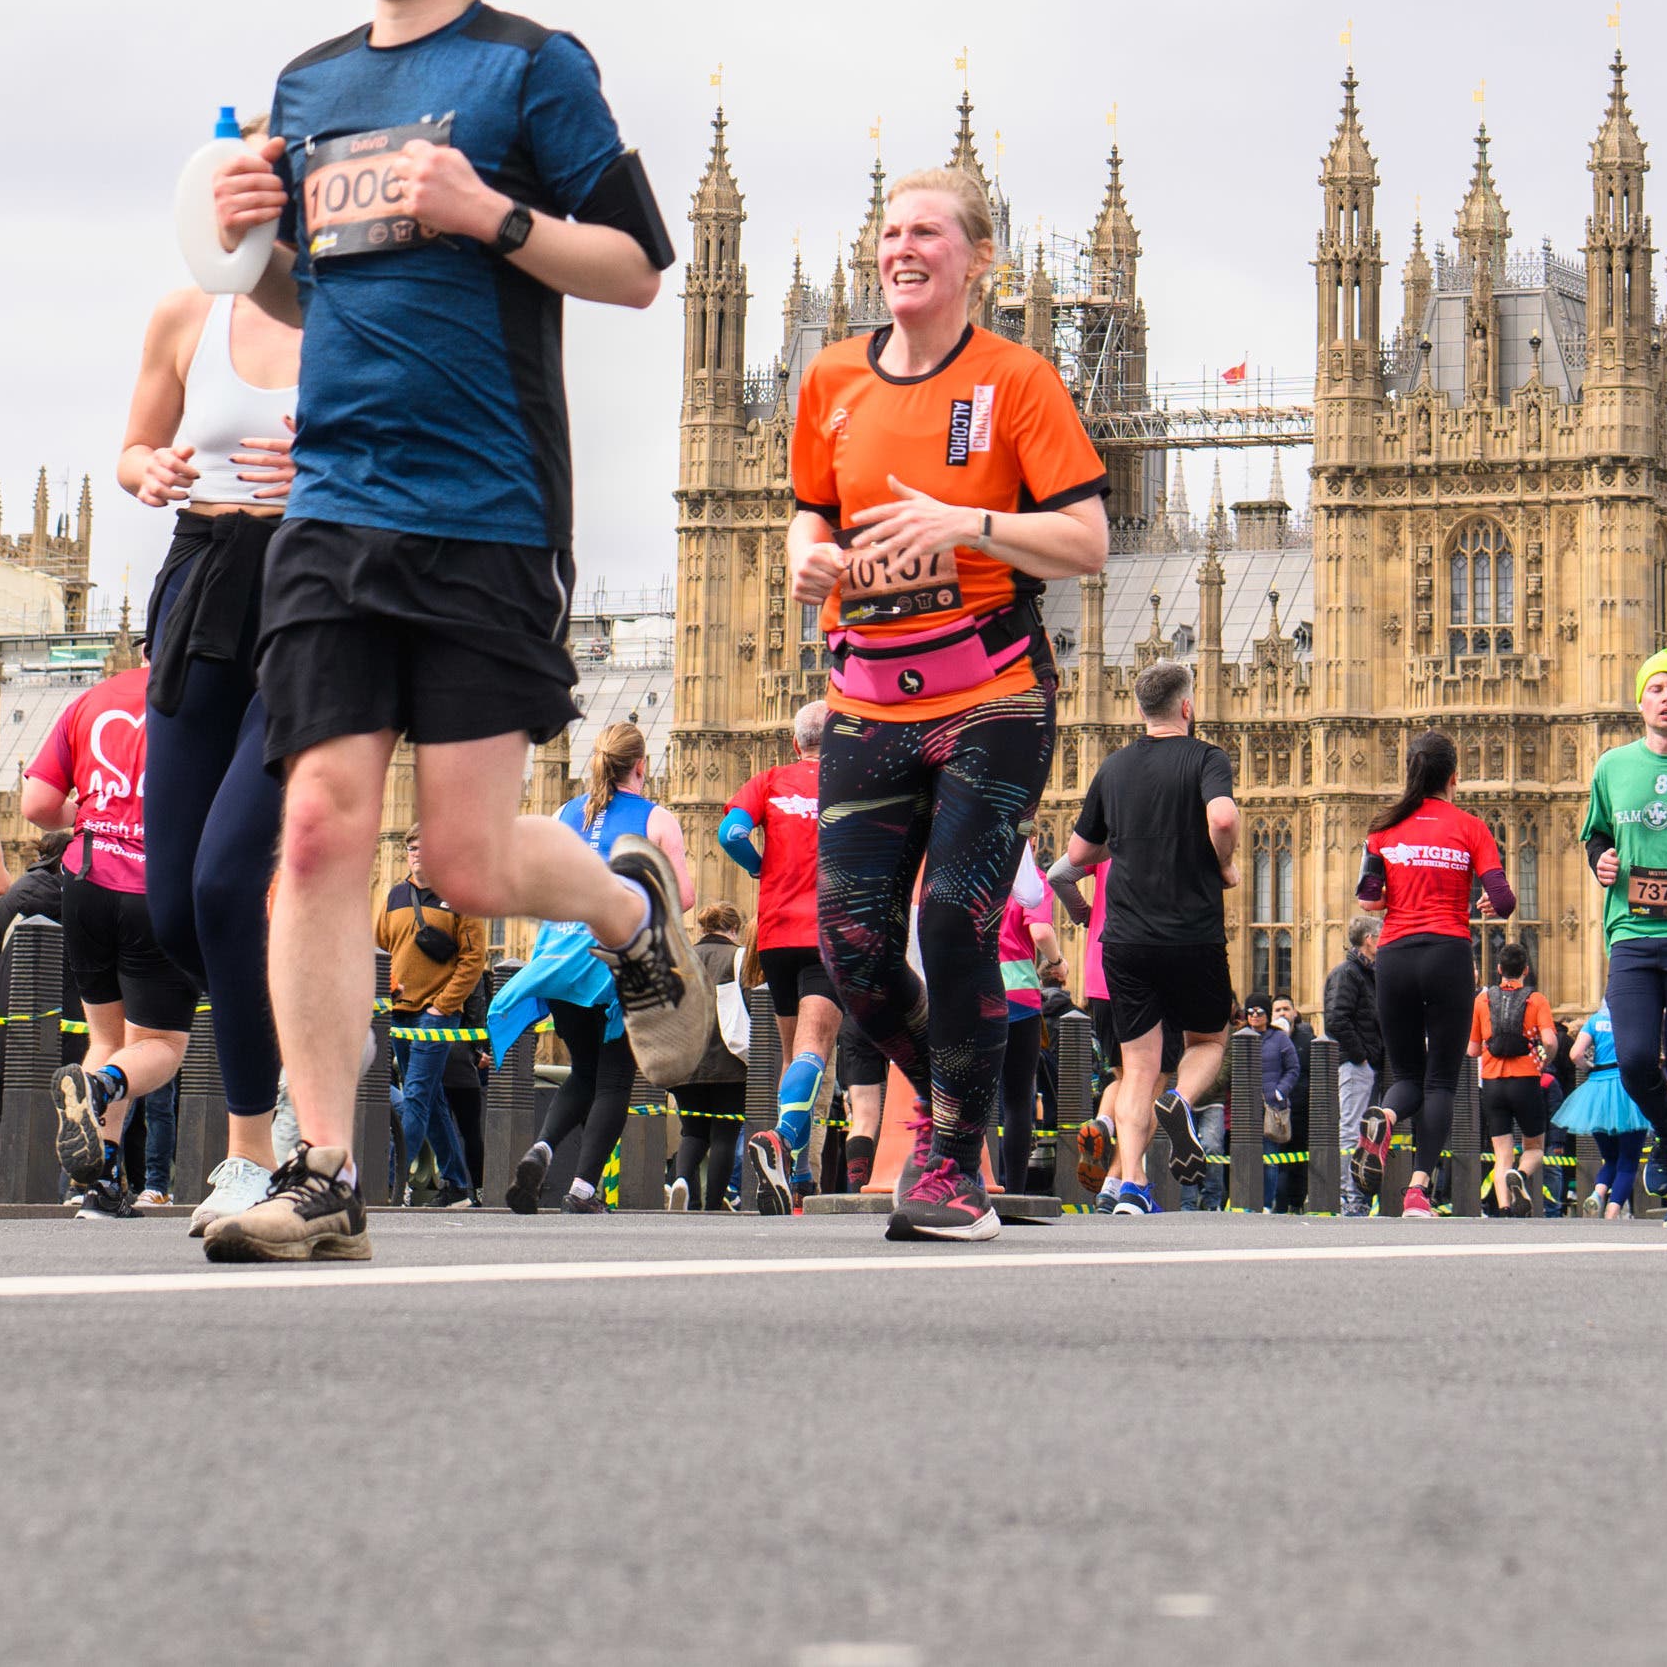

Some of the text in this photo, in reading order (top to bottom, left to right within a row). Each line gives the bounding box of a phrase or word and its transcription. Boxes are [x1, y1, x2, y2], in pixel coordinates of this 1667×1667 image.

[349, 135, 389, 154] DAVID
[311, 165, 408, 220] 1006
[948, 401, 971, 465] ALCOHOL
[1411, 845, 1471, 865] TIGERS
